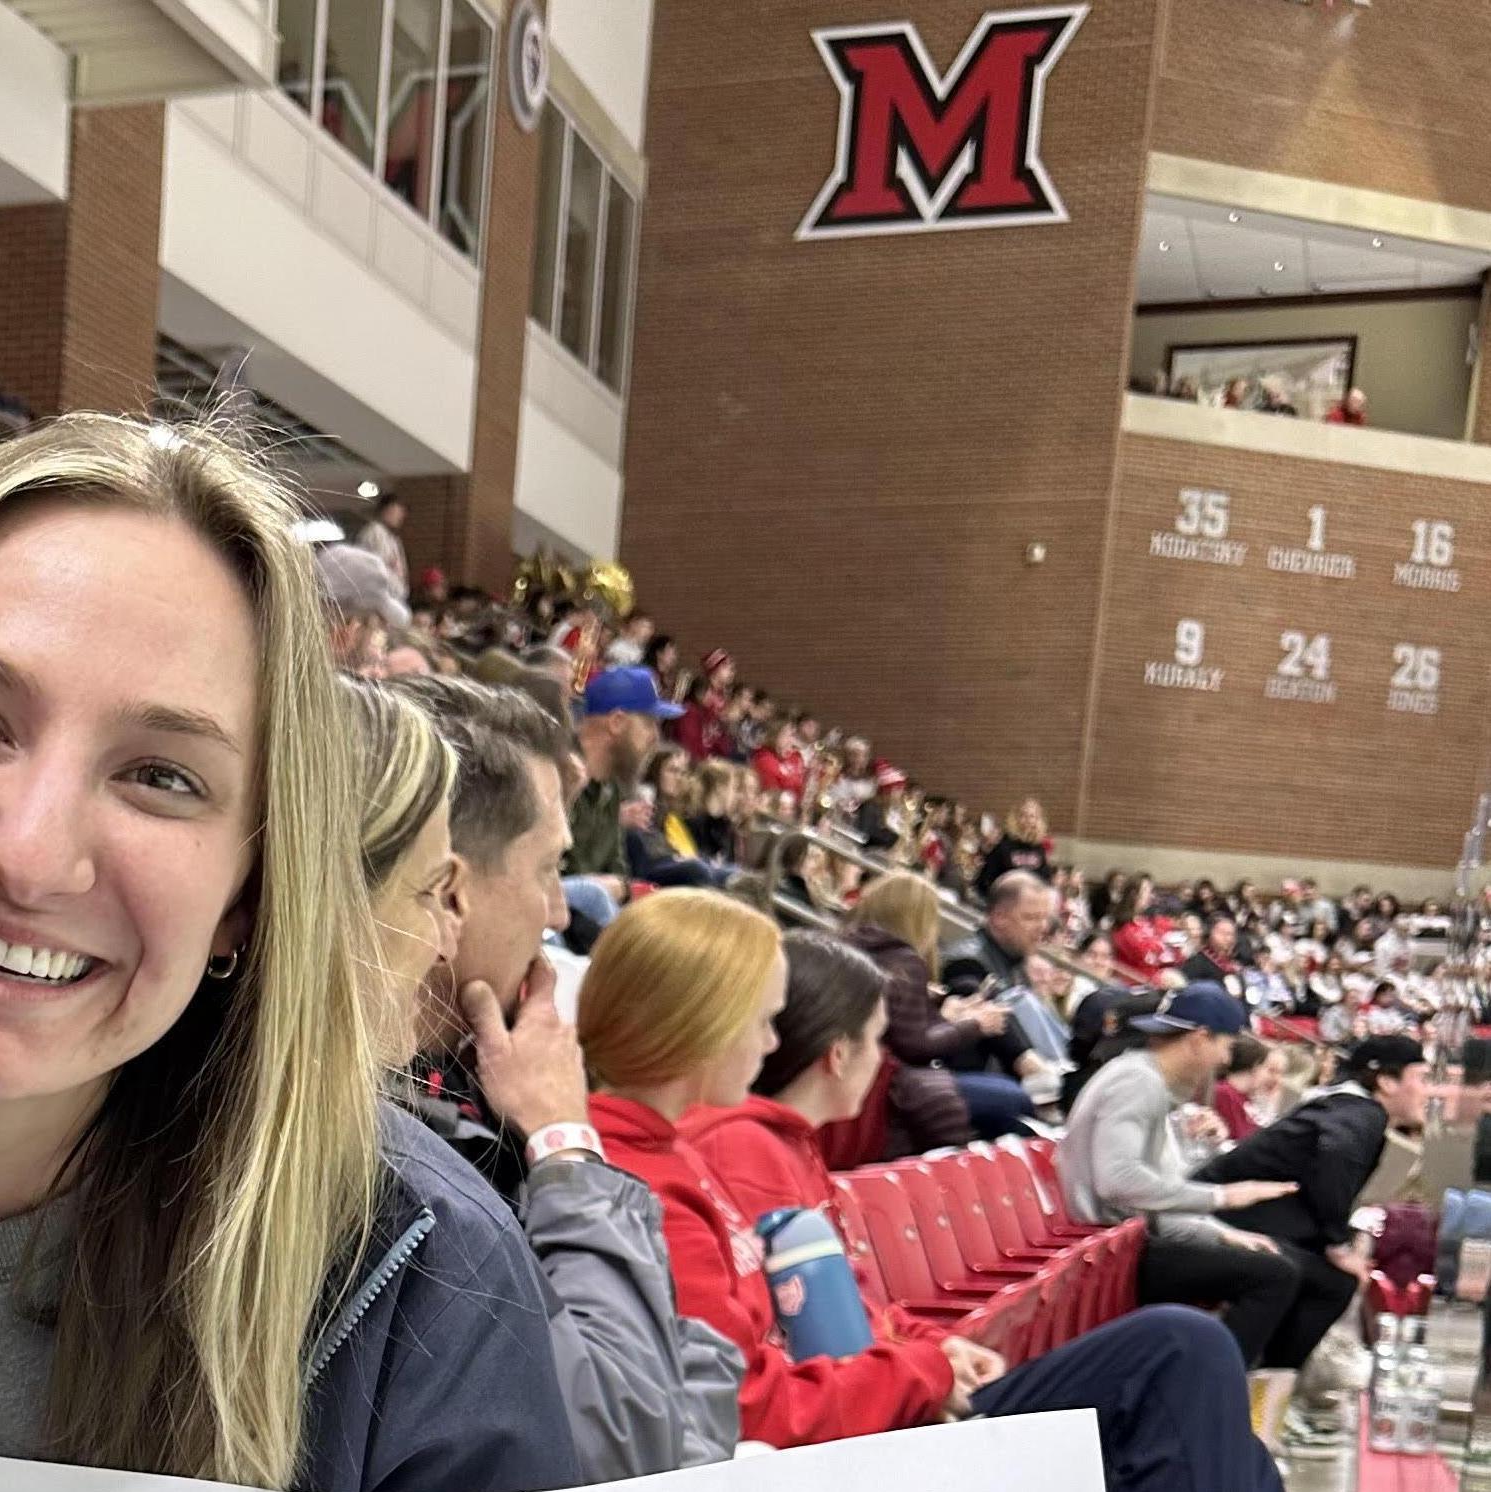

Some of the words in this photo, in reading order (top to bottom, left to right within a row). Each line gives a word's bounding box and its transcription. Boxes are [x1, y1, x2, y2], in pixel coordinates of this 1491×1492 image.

[796, 4, 1088, 240] M
[1175, 487, 1230, 538] 35
[1307, 503, 1326, 550] 1
[1411, 518, 1455, 566] 16
[1175, 617, 1205, 666] 9
[1277, 629, 1332, 681] 24
[1390, 641, 1442, 690] 26
